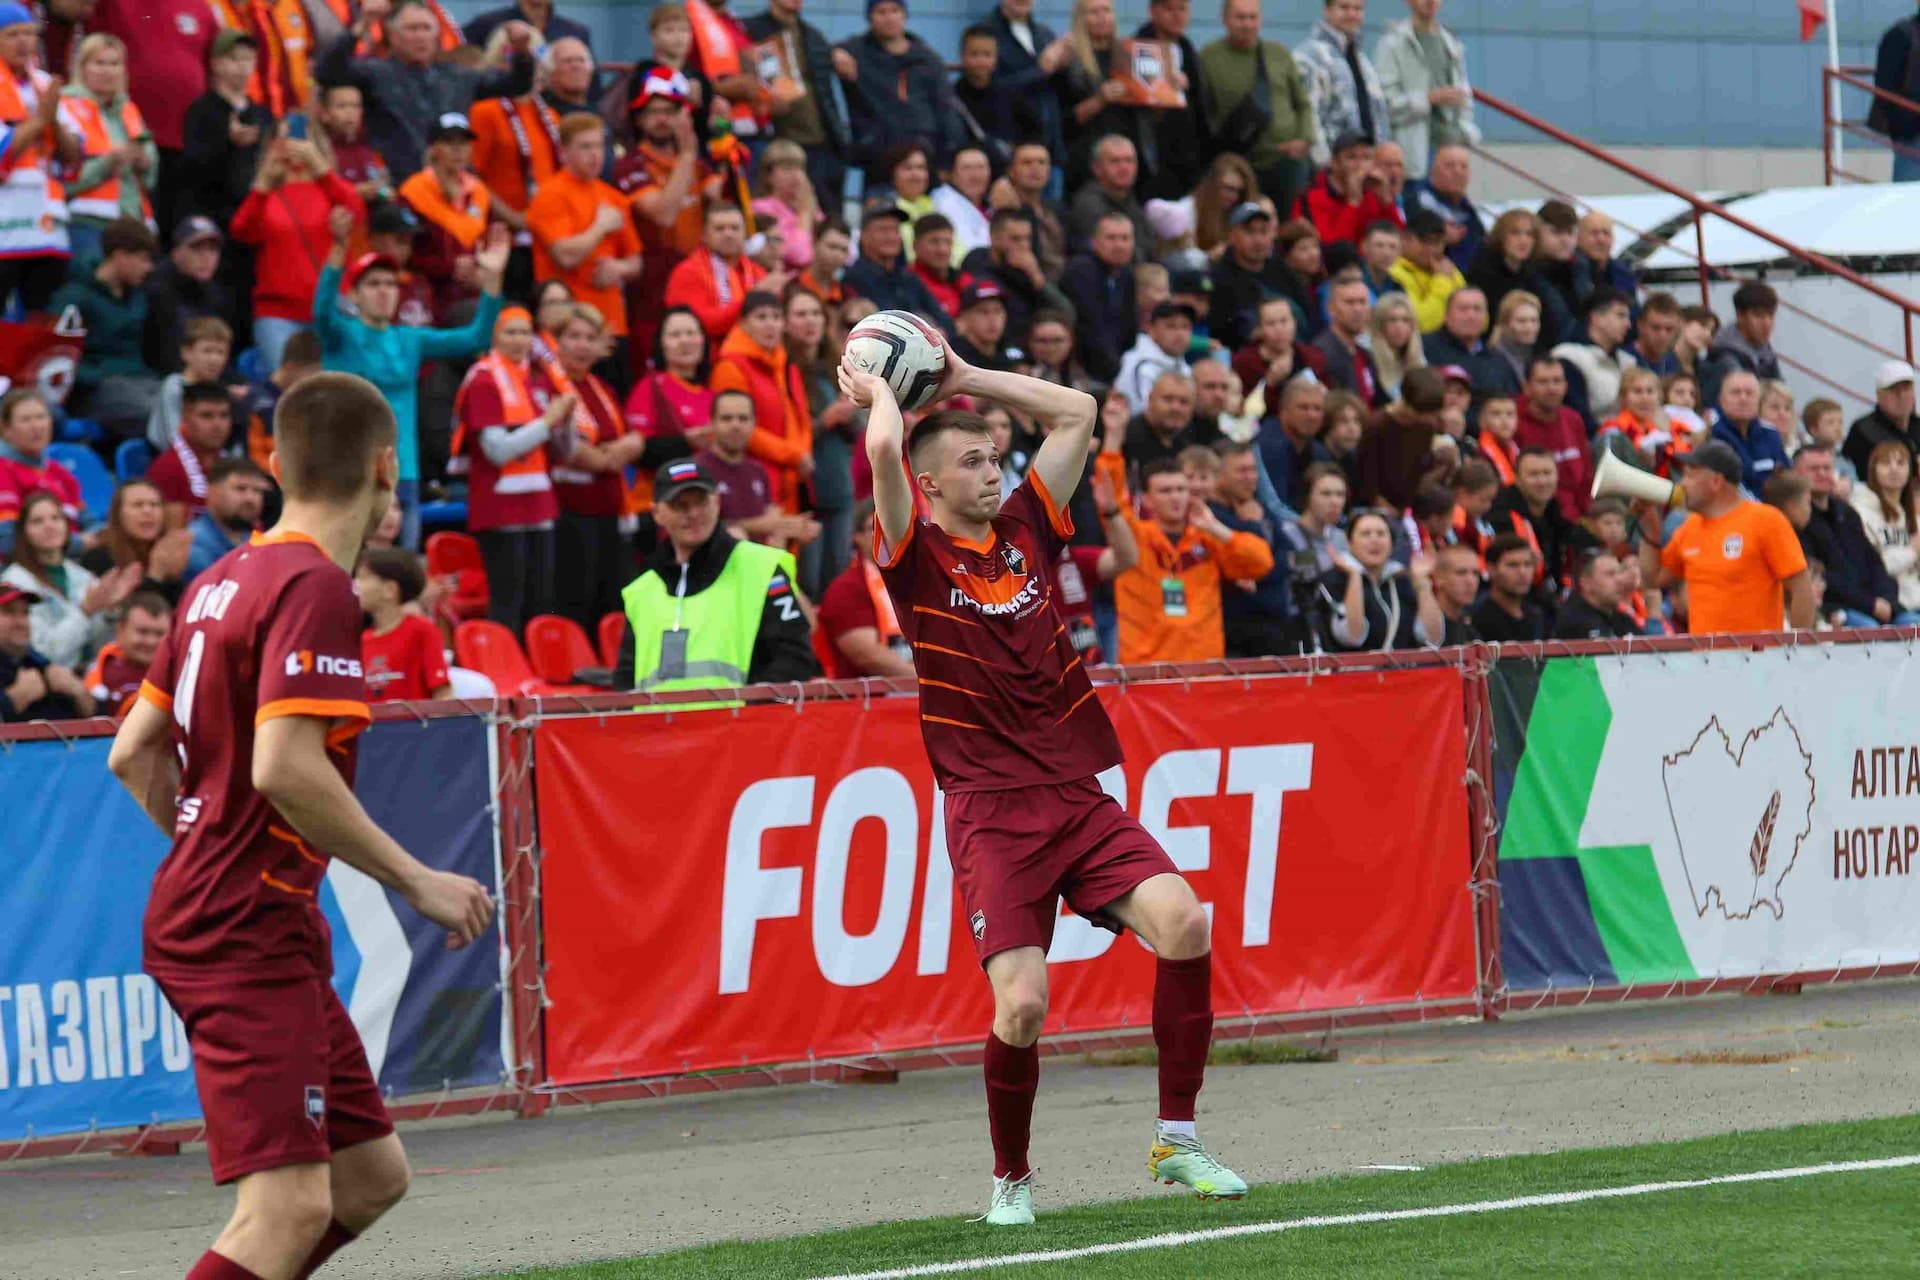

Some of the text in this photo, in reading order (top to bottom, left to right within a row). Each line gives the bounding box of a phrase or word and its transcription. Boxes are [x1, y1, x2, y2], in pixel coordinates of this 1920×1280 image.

[773, 595, 801, 621] Z
[316, 654, 364, 678] ПСБ
[1851, 745, 1920, 799] АЛТА
[718, 742, 1314, 995] FOET
[1833, 824, 1920, 880] НОТАР
